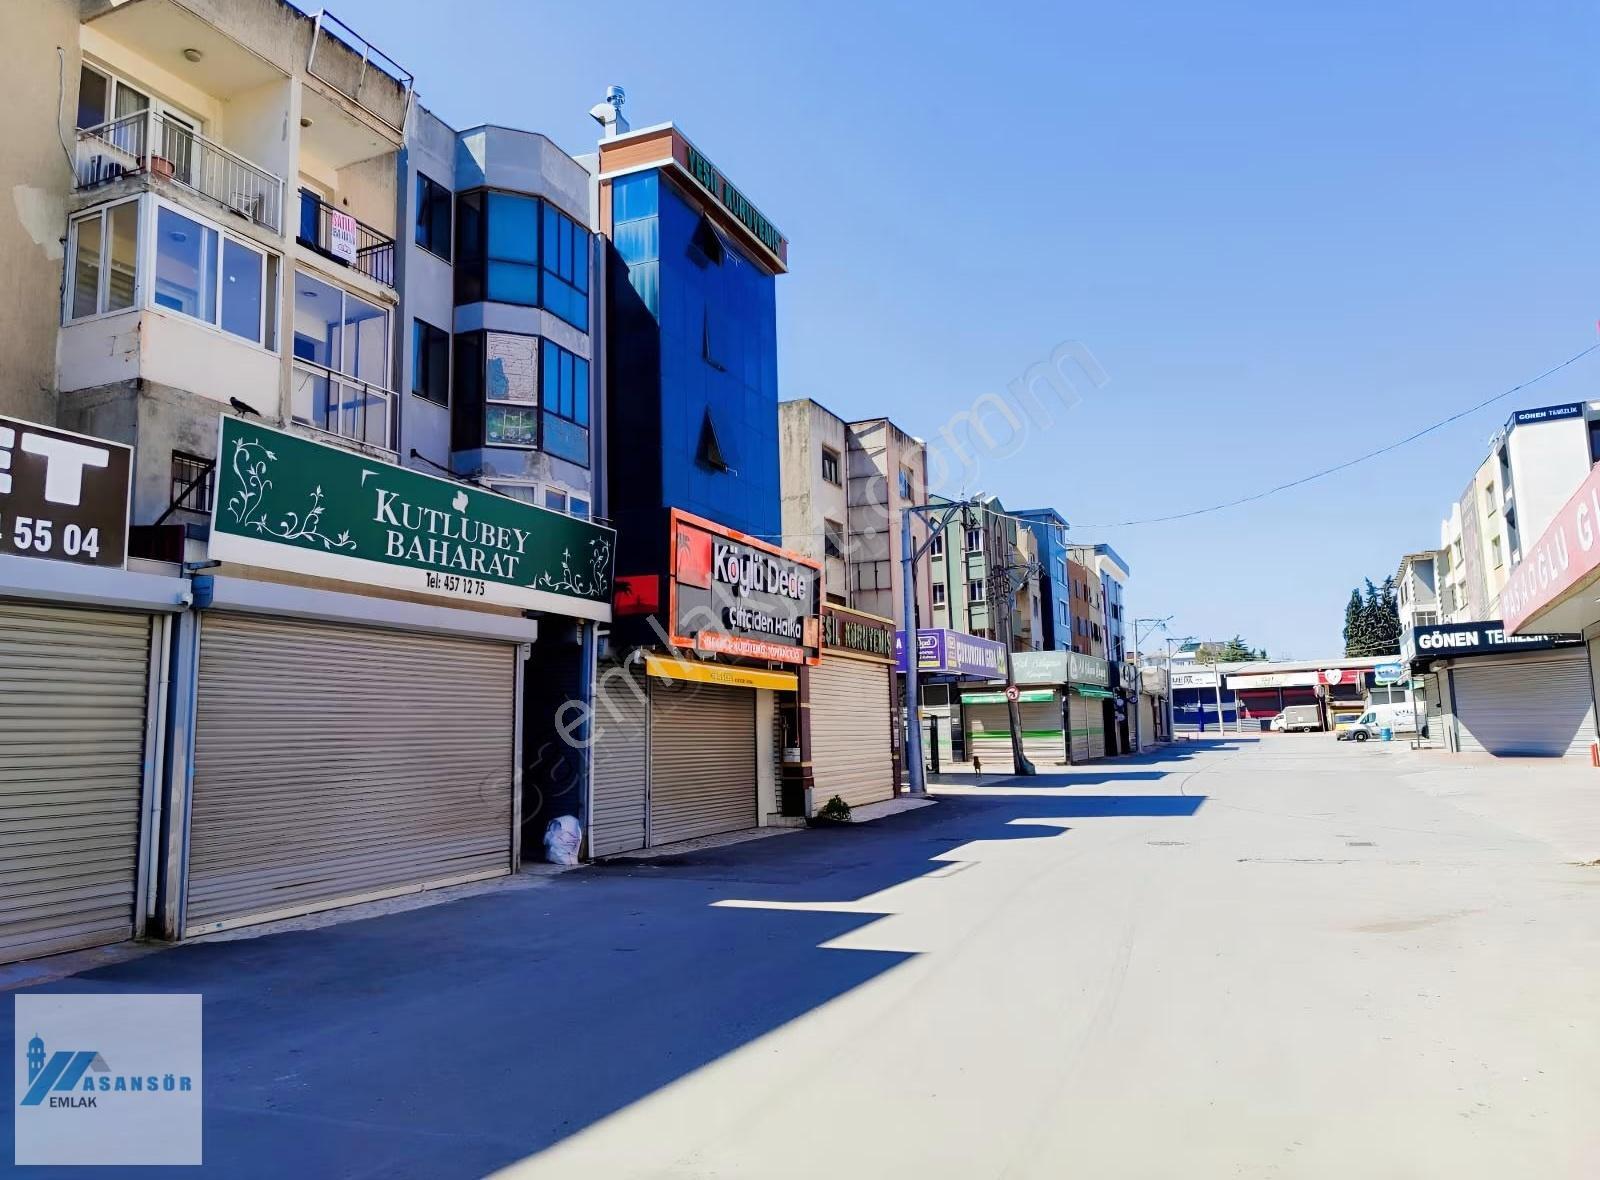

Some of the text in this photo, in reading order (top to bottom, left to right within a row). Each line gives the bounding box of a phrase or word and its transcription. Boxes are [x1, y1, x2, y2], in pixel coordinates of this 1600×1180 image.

[0, 425, 110, 507] T
[13, 515, 100, 558] 55 04
[373, 488, 531, 554] KUTLUBEY
[385, 529, 520, 579] BAHARAT
[714, 543, 806, 600] Köylü Dede
[426, 572, 485, 596] Tel: 457 12 75
[1418, 630, 1478, 650] GÖNEN
